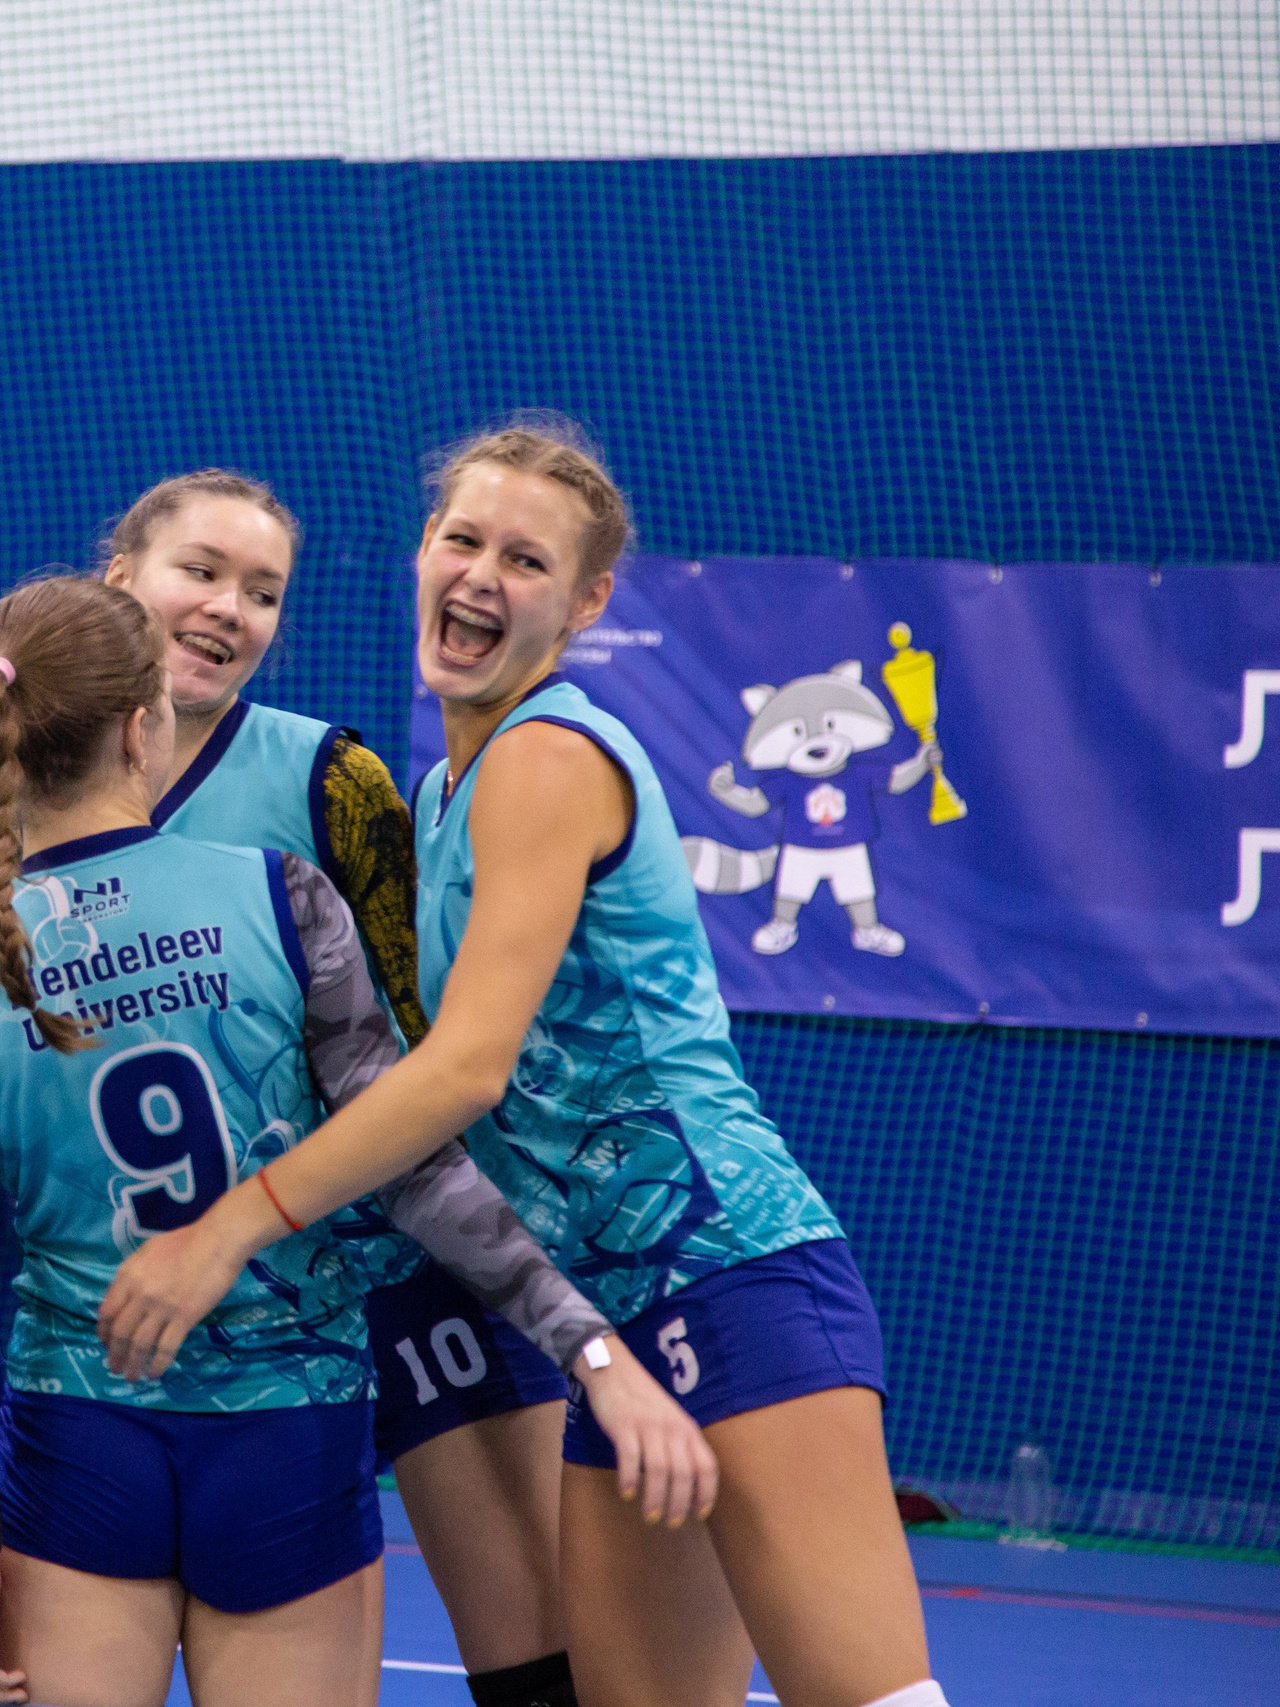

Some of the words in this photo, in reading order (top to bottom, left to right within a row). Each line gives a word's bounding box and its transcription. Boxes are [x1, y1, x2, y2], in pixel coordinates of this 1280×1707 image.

[70, 894, 131, 919] SPORT
[22, 970, 228, 1052] Uiversity
[90, 1041, 237, 1240] 9
[395, 1318, 487, 1405] 10
[657, 1316, 700, 1395] 5
